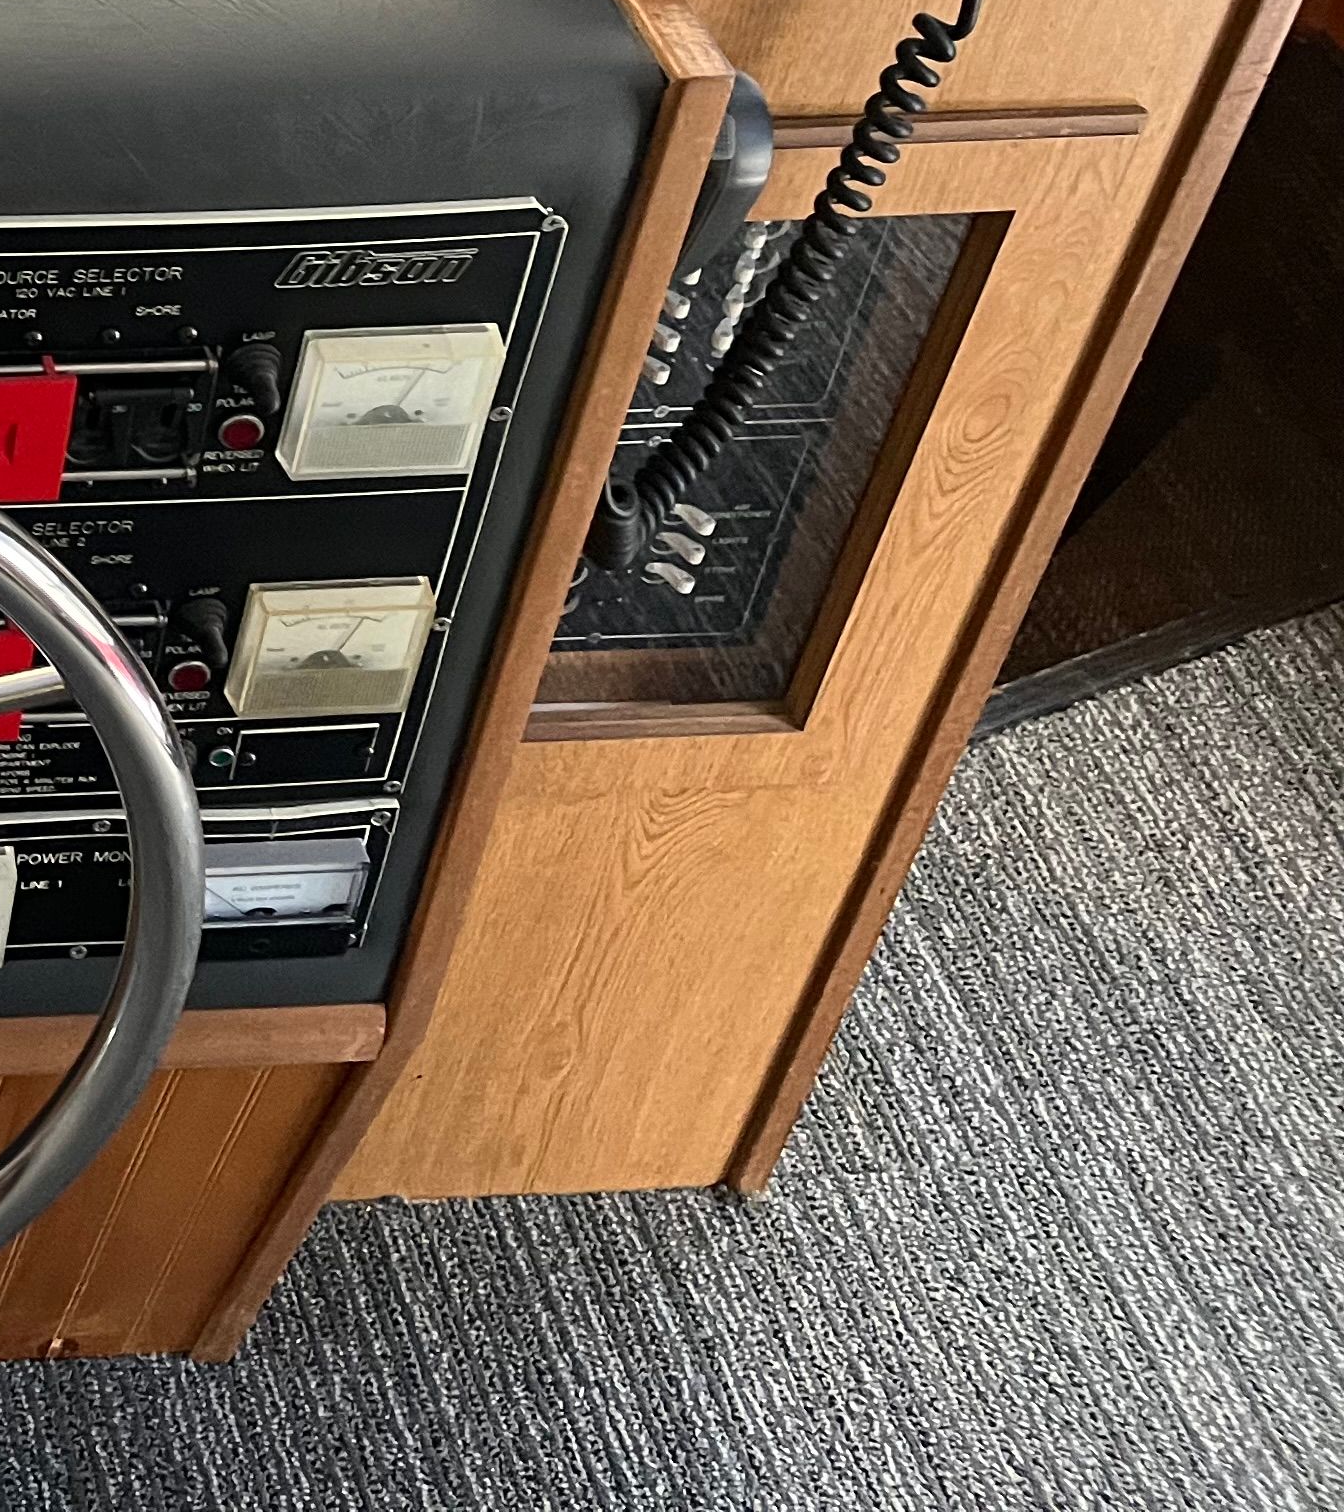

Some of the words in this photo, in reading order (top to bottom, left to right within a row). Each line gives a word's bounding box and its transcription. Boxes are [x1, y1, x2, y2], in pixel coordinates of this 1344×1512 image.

[274, 249, 474, 288] Gibson
[73, 267, 183, 283] SELECTOR
[47, 288, 76, 298] VAC
[83, 287, 113, 296] LINE
[135, 305, 181, 316] SHORE
[32, 521, 134, 536] SELECTOR
[91, 555, 133, 564] SHORE
[17, 851, 83, 865] POWER
[21, 880, 49, 889] LINE
